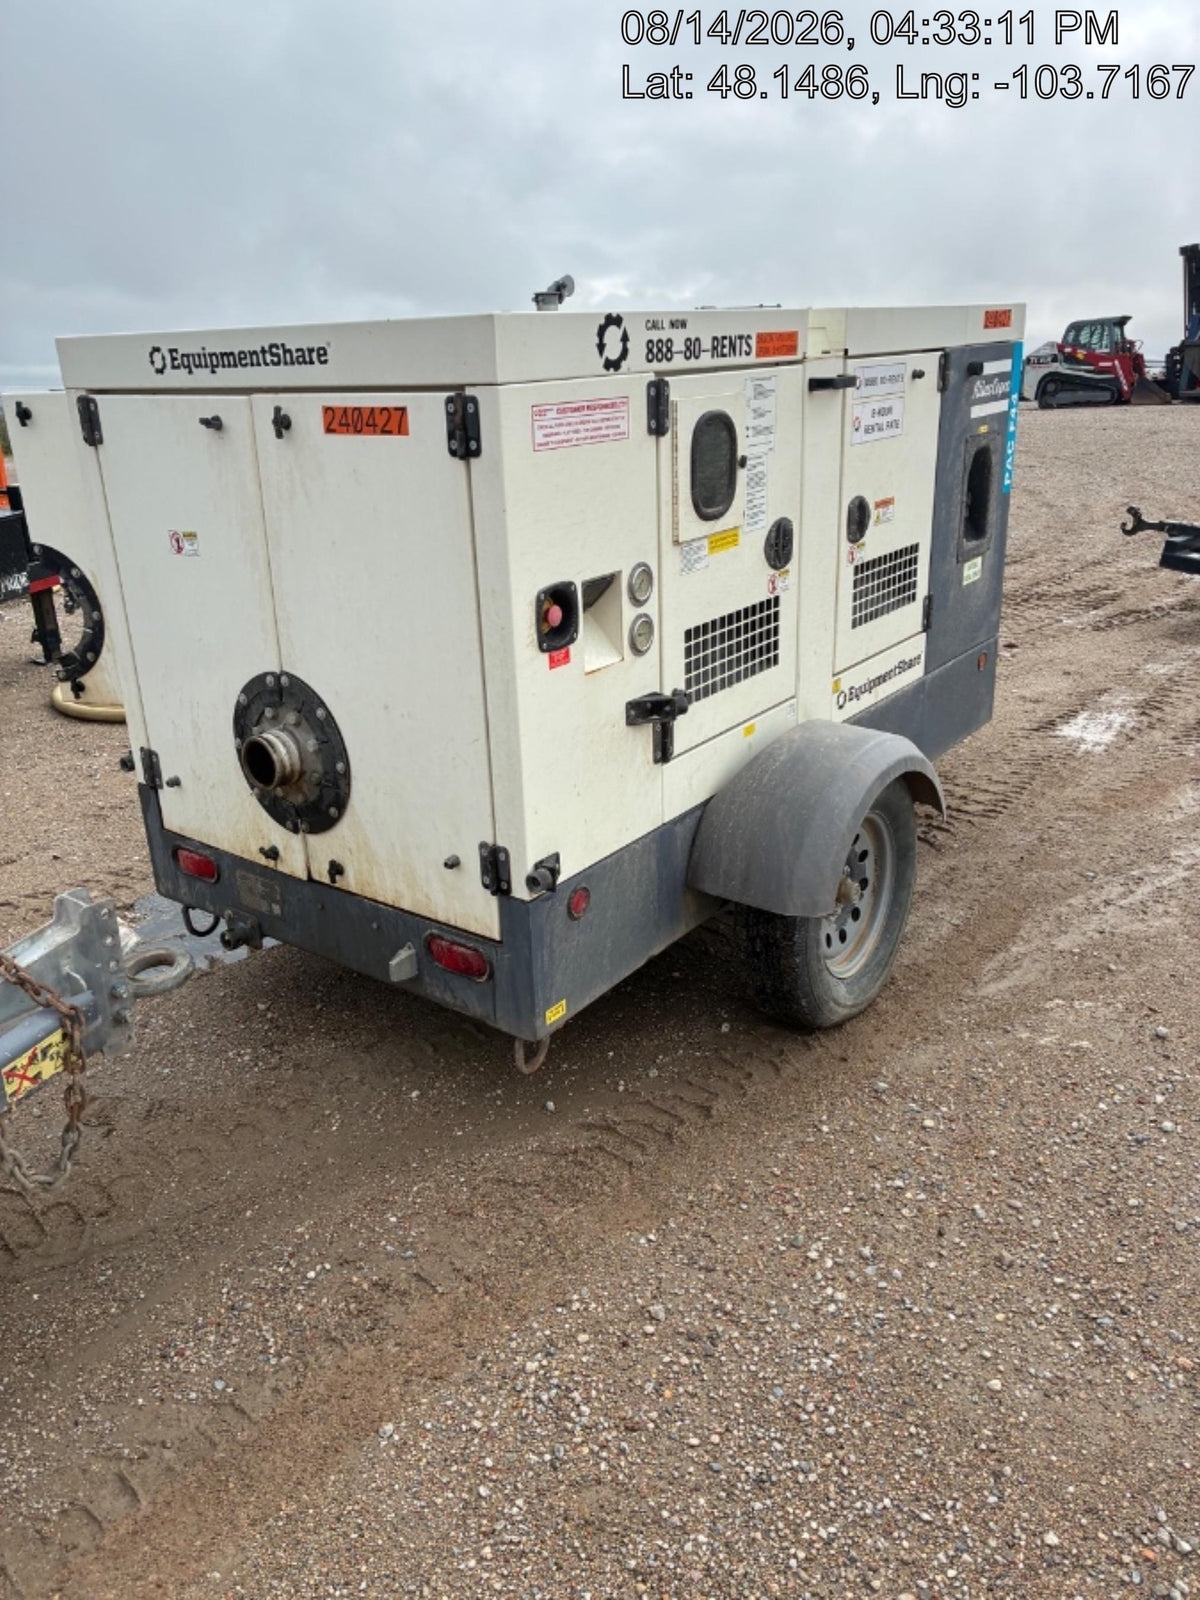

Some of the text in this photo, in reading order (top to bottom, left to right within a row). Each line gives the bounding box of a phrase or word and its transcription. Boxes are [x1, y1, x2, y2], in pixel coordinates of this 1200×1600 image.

[645, 318, 688, 331] CALL NOW
[170, 343, 329, 374] EquipmentShare
[645, 334, 752, 363] 888-80-RENTS
[324, 407, 408, 435] 240427
[848, 653, 922, 702] EquipmentShare
